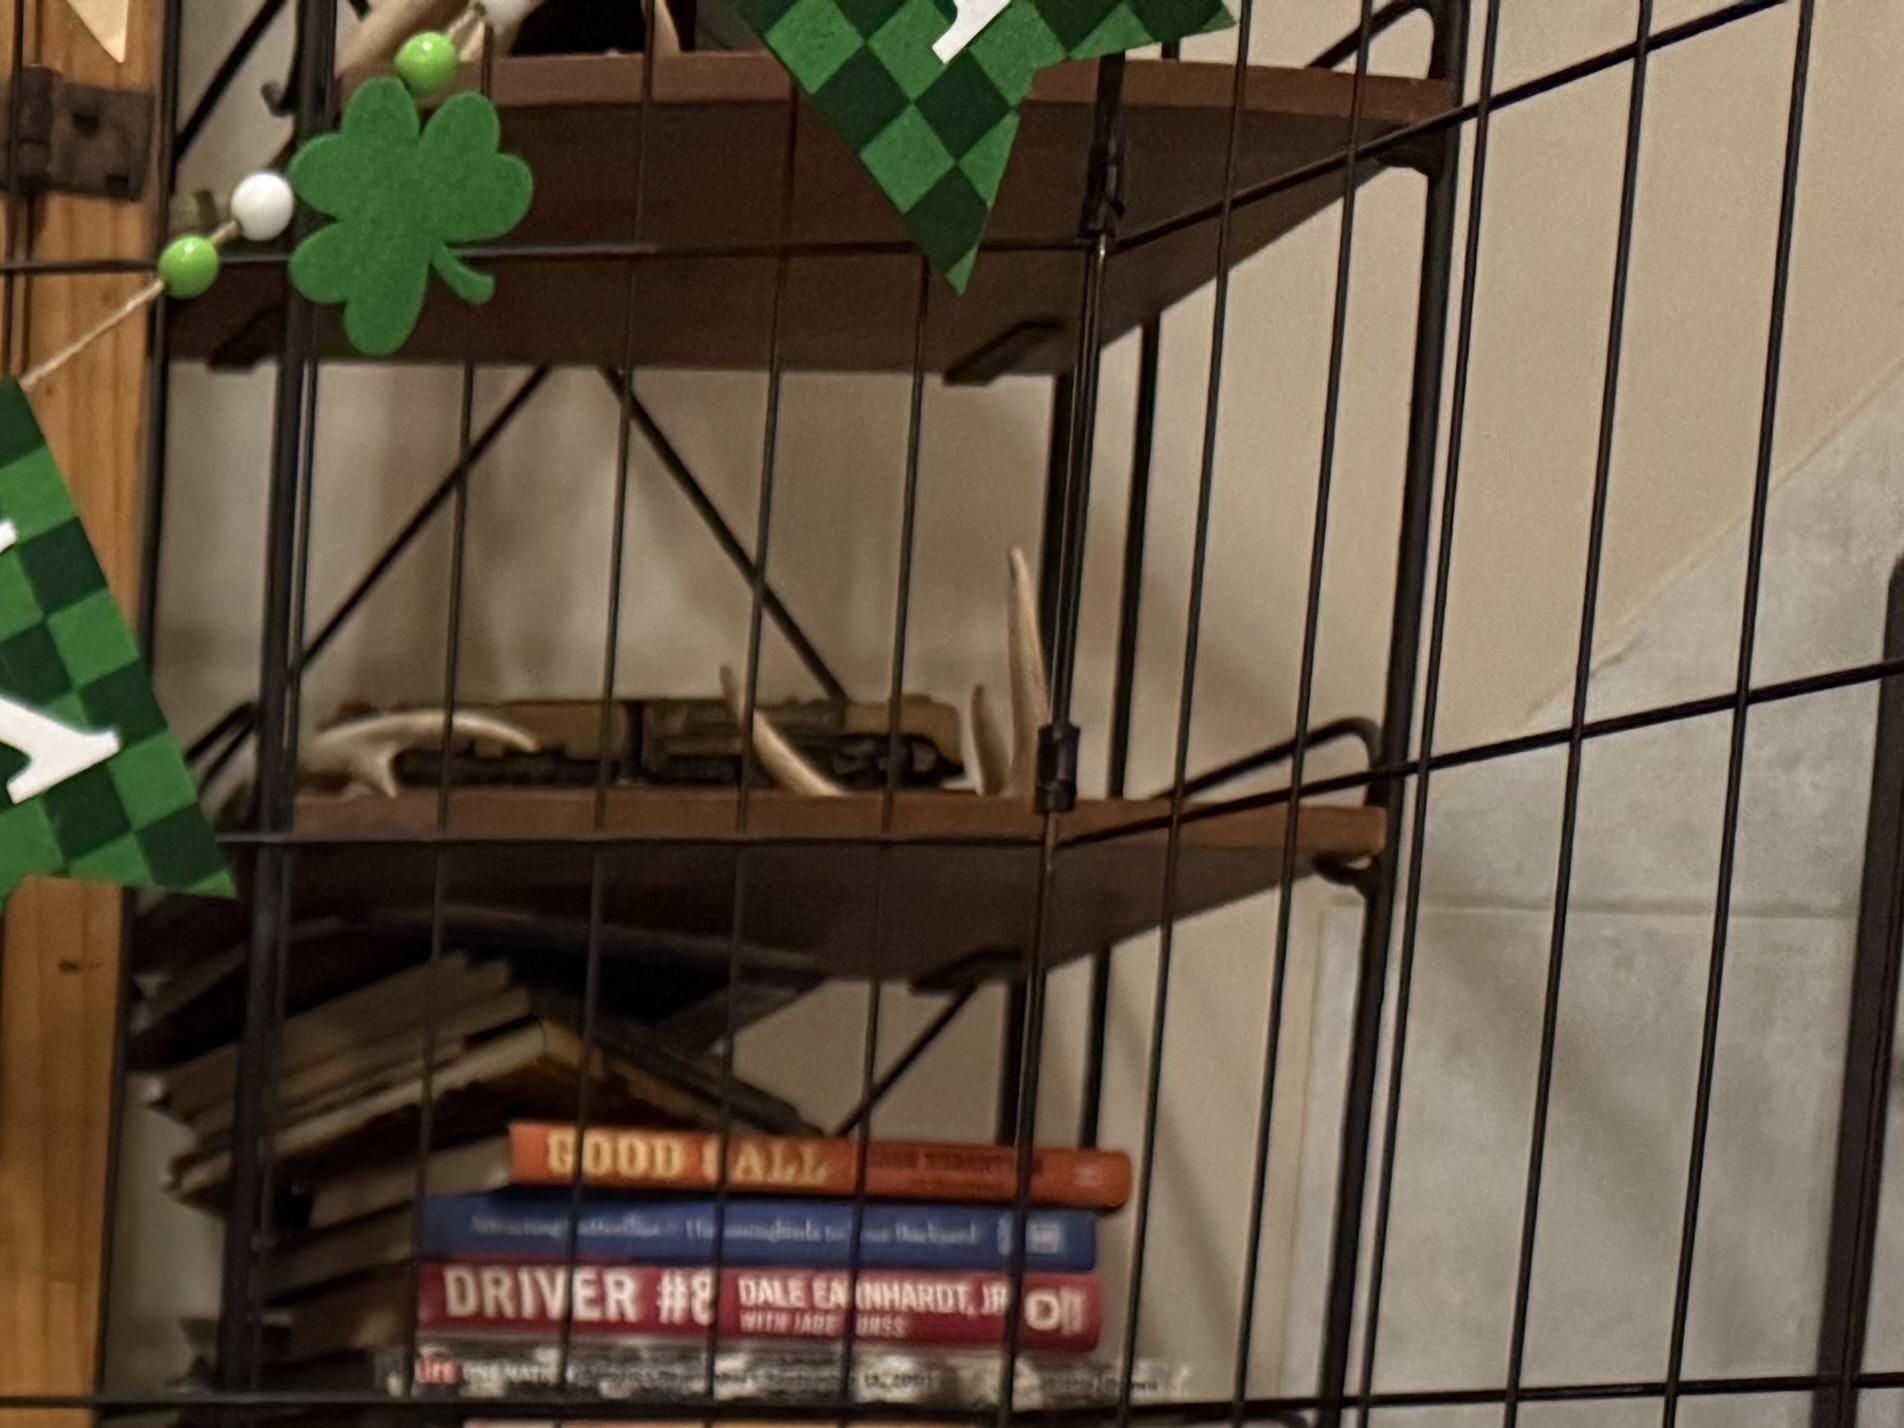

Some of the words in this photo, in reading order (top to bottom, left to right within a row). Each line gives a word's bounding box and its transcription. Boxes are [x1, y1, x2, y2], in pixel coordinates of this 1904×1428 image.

[547, 1128, 687, 1179] GOOD
[442, 1265, 642, 1323] DRIVER
[656, 1270, 717, 1326] #8
[737, 1277, 805, 1309] DALE
